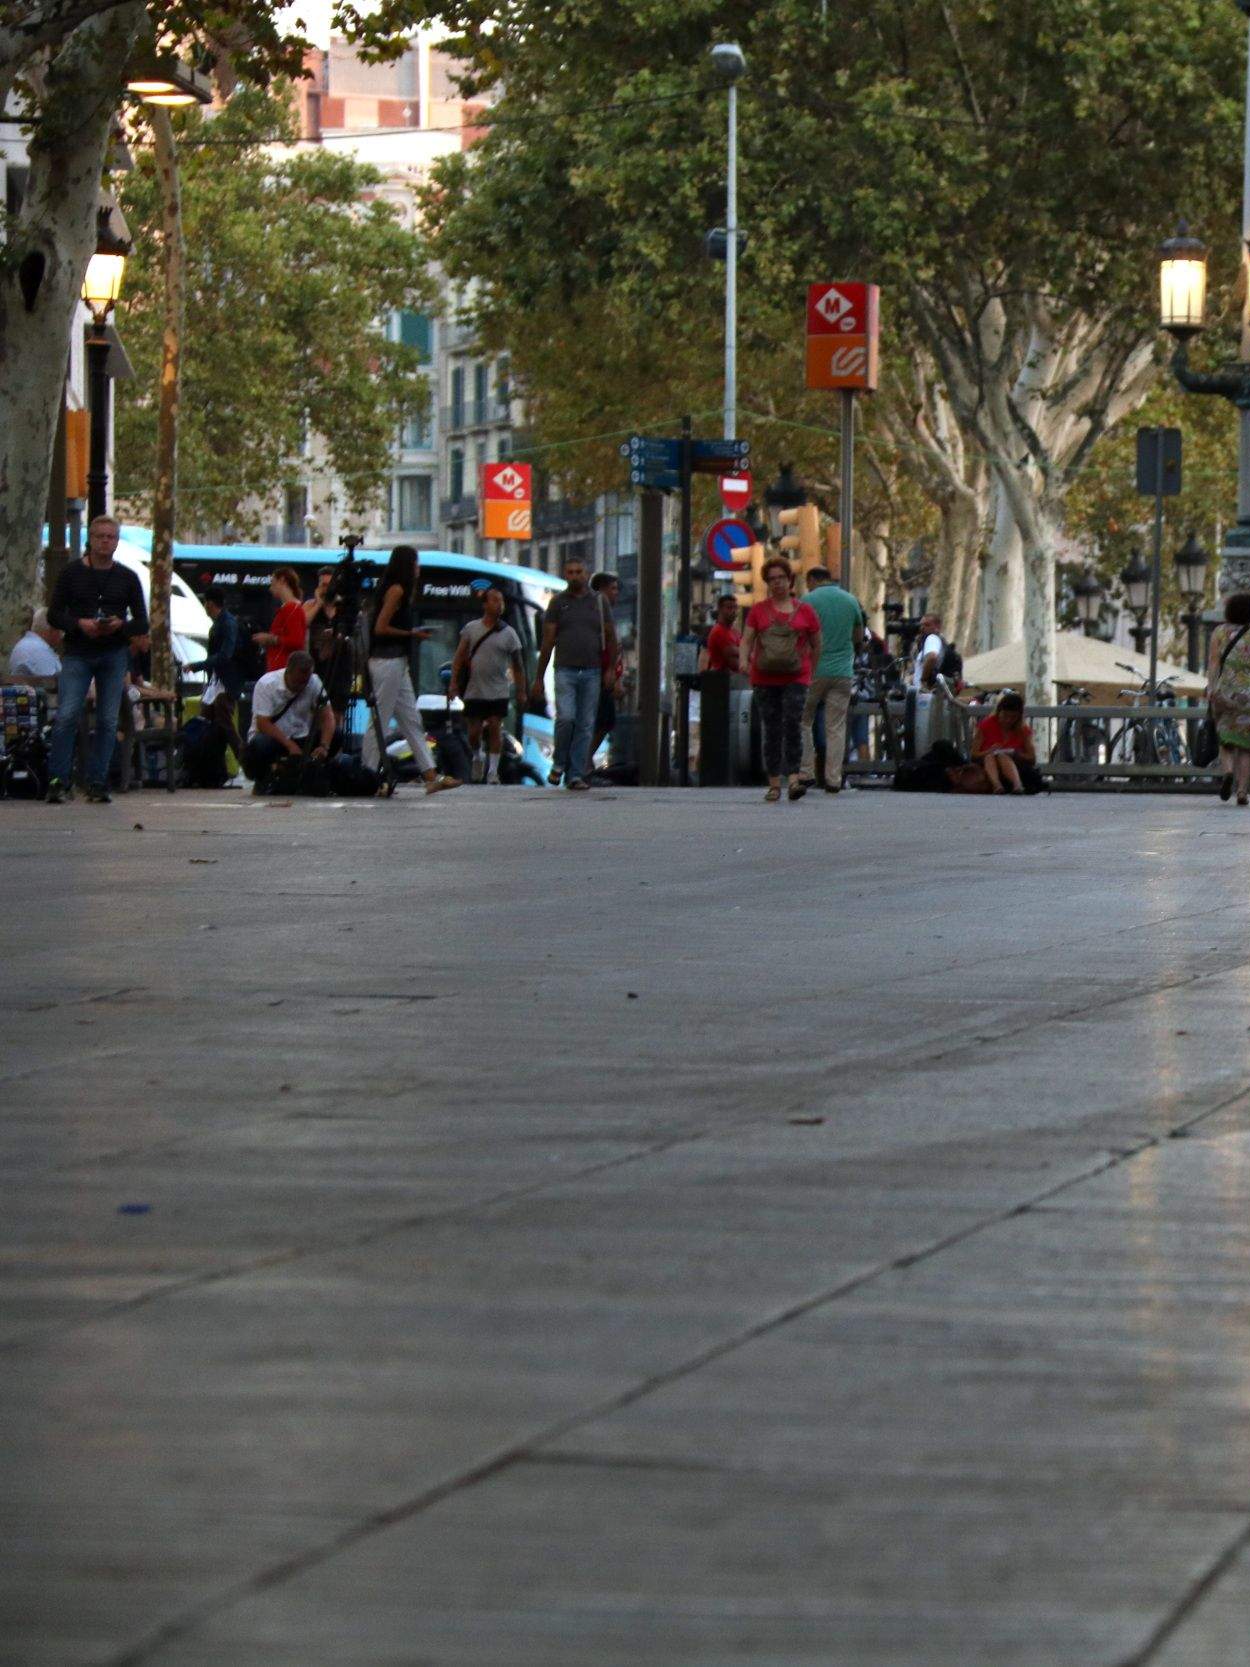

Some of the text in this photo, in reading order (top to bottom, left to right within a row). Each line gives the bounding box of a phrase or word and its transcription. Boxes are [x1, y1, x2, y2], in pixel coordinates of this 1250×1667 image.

[825, 297, 840, 314] M
[502, 473, 515, 485] M
[212, 573, 238, 584] AMB
[423, 583, 448, 596] Free
